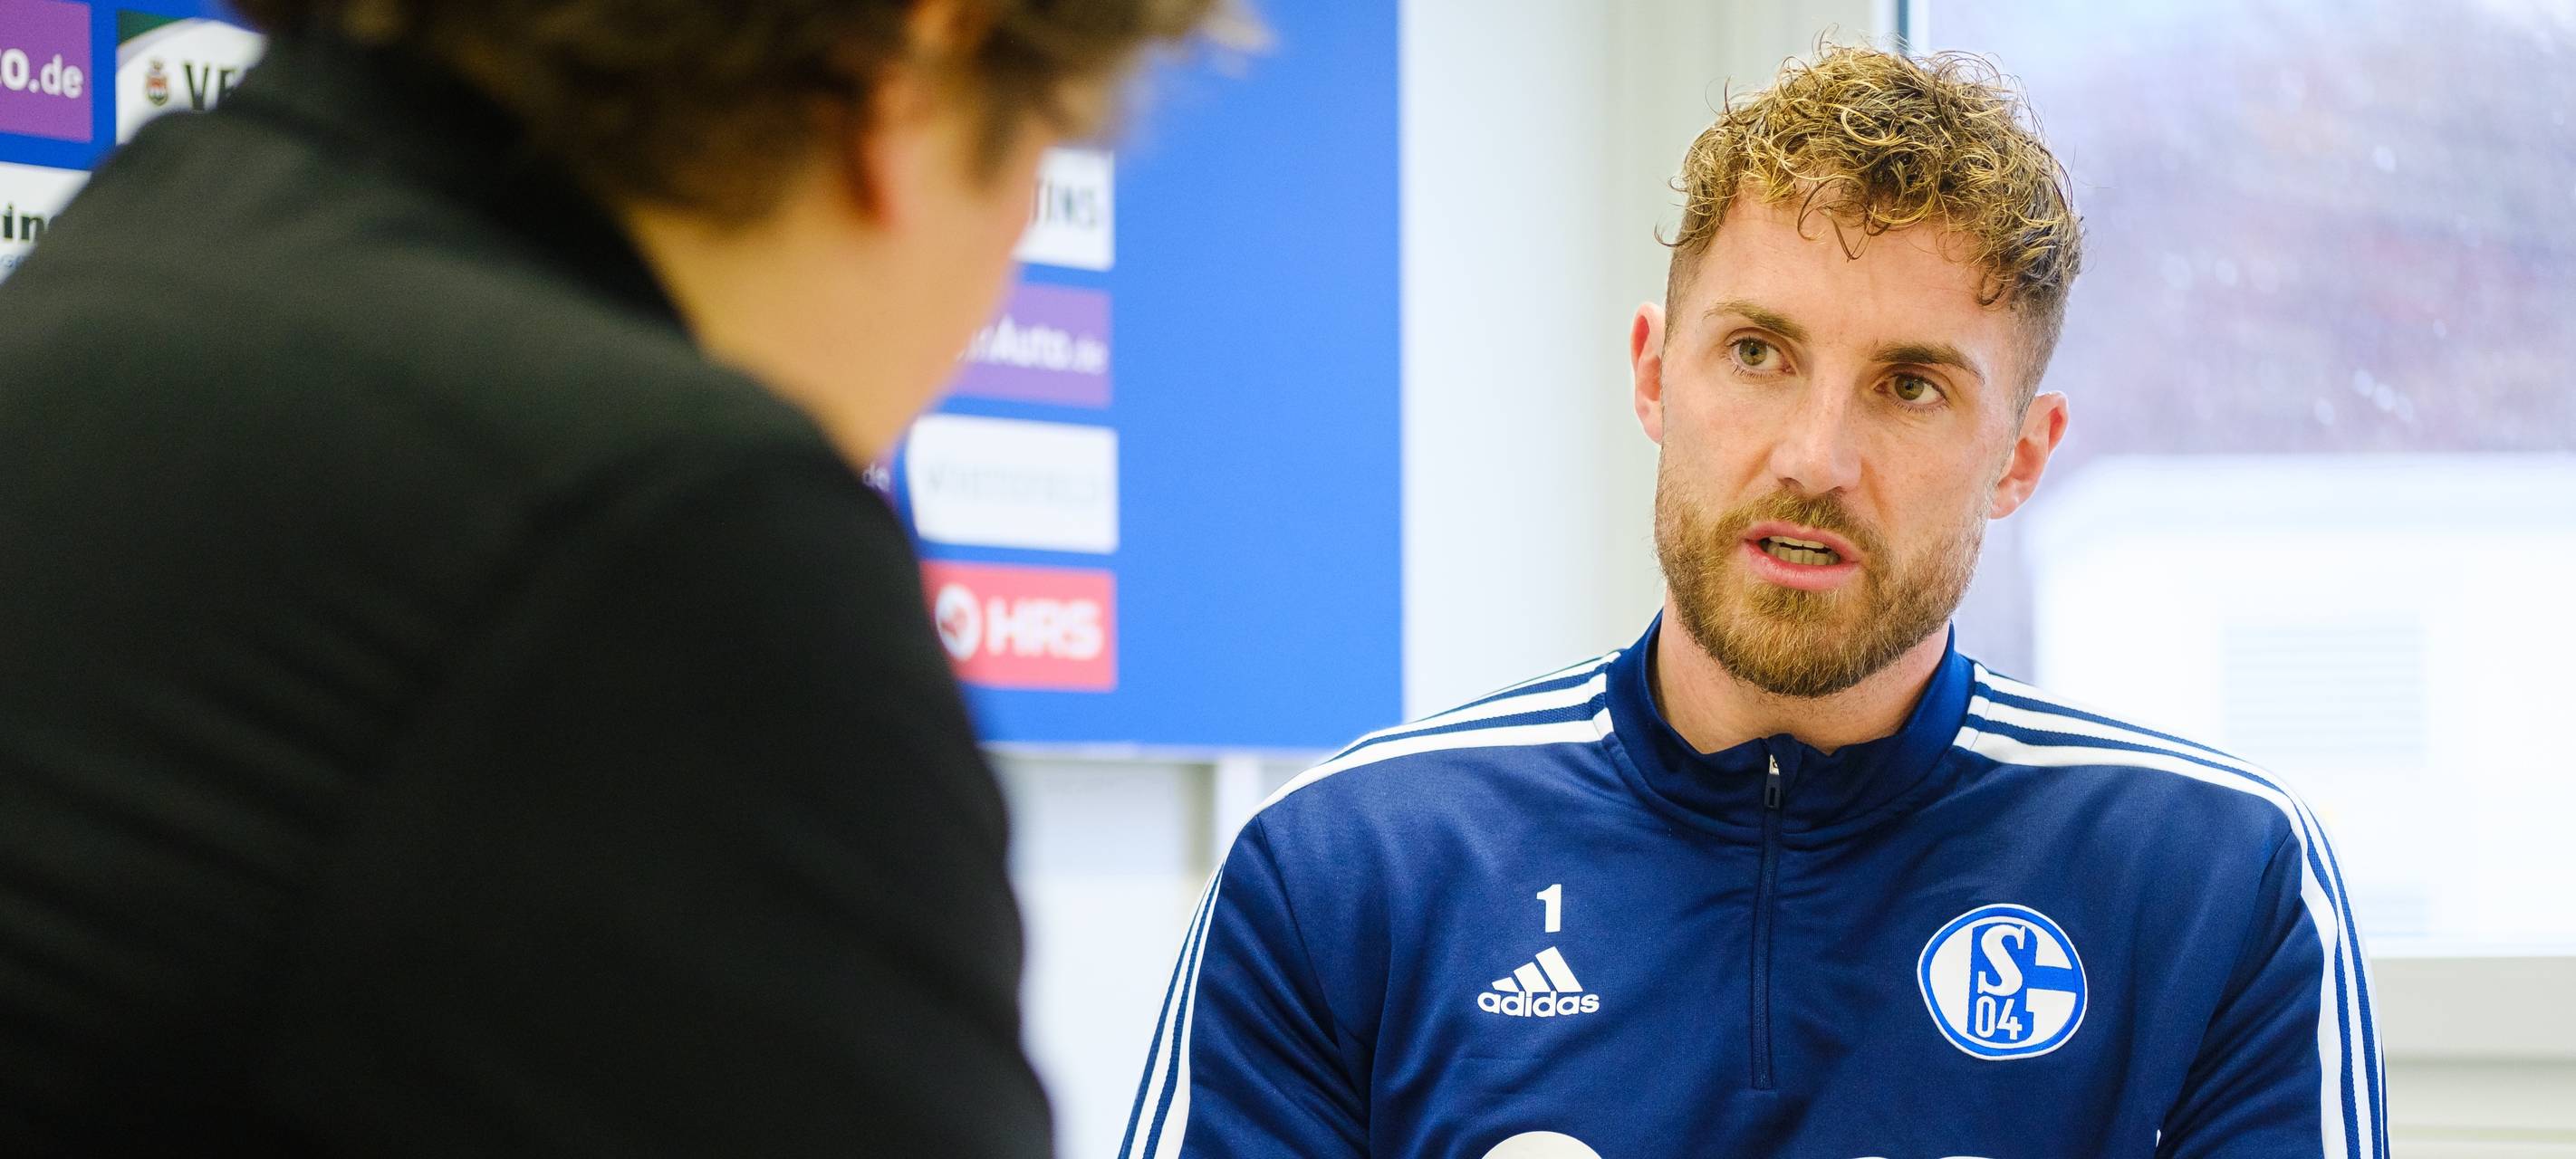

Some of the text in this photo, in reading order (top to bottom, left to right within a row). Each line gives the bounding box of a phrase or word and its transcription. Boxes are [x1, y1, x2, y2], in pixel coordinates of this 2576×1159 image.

[985, 597, 1104, 660] HRS
[1537, 884, 1562, 933] 1
[1477, 991, 1600, 1018] adidas
[1975, 996, 2023, 1039] 04
